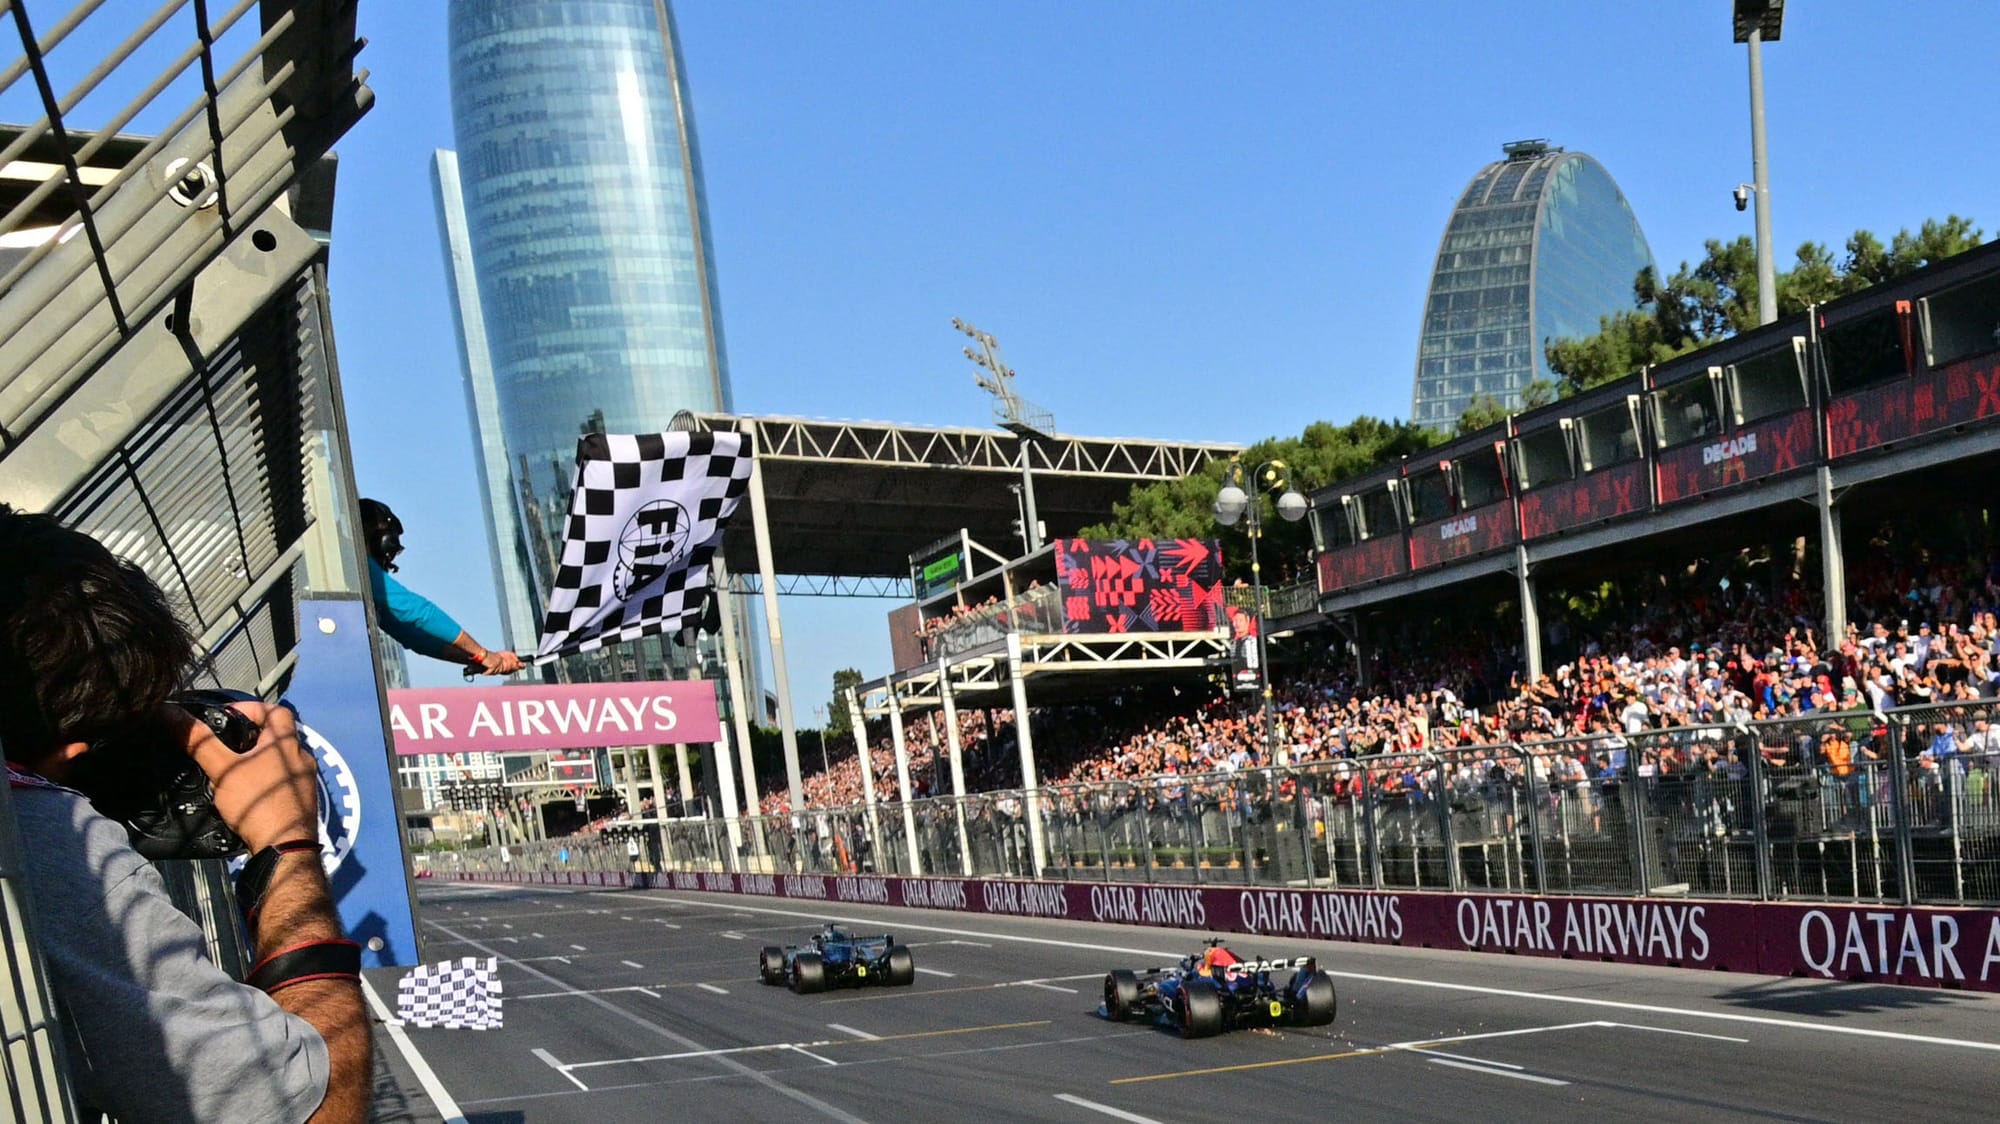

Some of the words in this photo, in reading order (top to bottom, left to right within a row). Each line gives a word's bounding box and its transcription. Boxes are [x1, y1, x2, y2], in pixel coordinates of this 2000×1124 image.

[1703, 432, 1757, 465] DECADE
[468, 695, 677, 738] AIRWAYS
[902, 880, 929, 906] QATAR
[930, 882, 967, 908] AIRWAYS
[984, 882, 1019, 912] QATAR
[1021, 884, 1068, 916] AIRWAYS
[1091, 885, 1138, 922] QATAR
[1141, 888, 1206, 926] AIRWAYS
[1240, 891, 1304, 933] QATAR
[1310, 894, 1403, 941] AIRWAYS
[1457, 898, 1554, 950] QATAR
[1563, 902, 1709, 961] AIRWAYS
[1226, 956, 1309, 974] ORACLE
[1799, 911, 1966, 979] QATAR
